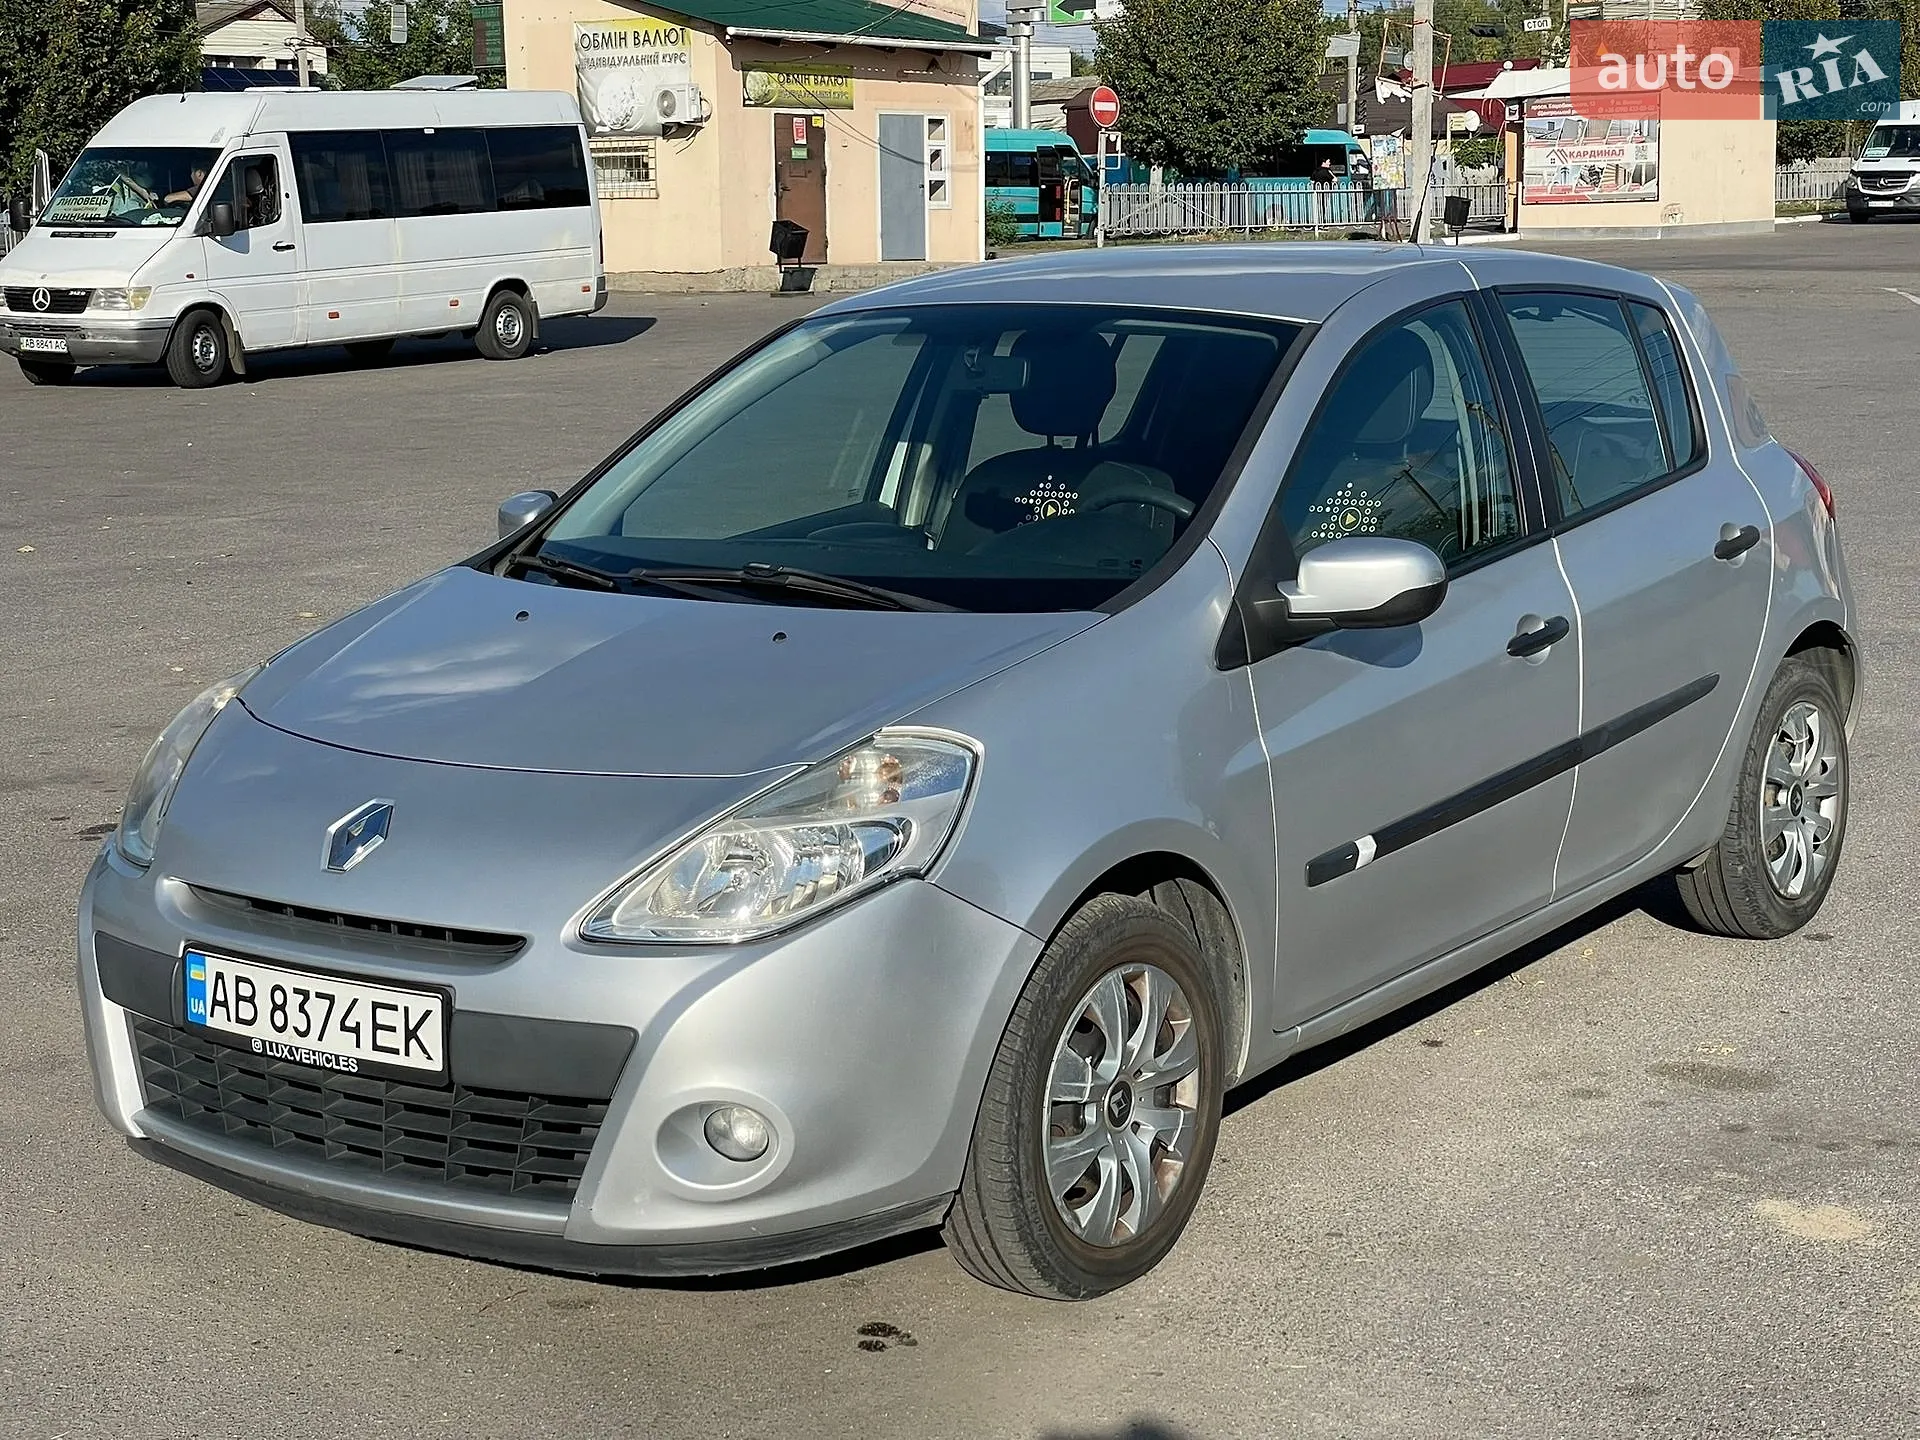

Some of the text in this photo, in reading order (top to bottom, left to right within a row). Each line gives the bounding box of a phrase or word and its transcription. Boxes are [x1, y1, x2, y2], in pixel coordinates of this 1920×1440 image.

[1526, 19, 1548, 29] СТОП
[580, 27, 687, 51] ОБМІН ВАЛЮТ
[662, 52, 687, 65] КУРС
[777, 72, 849, 88] ОБМІН ВАЛЮТ
[1568, 148, 1625, 160] КАРДИНАЛ
[57, 196, 109, 206] ЛИПОВЕЦЬ
[25, 338, 35, 349] AB
[190, 997, 206, 1016] UA
[209, 970, 434, 1062] AB 8374 EK
[265, 1040, 359, 1073] LUX.VEHICLES
